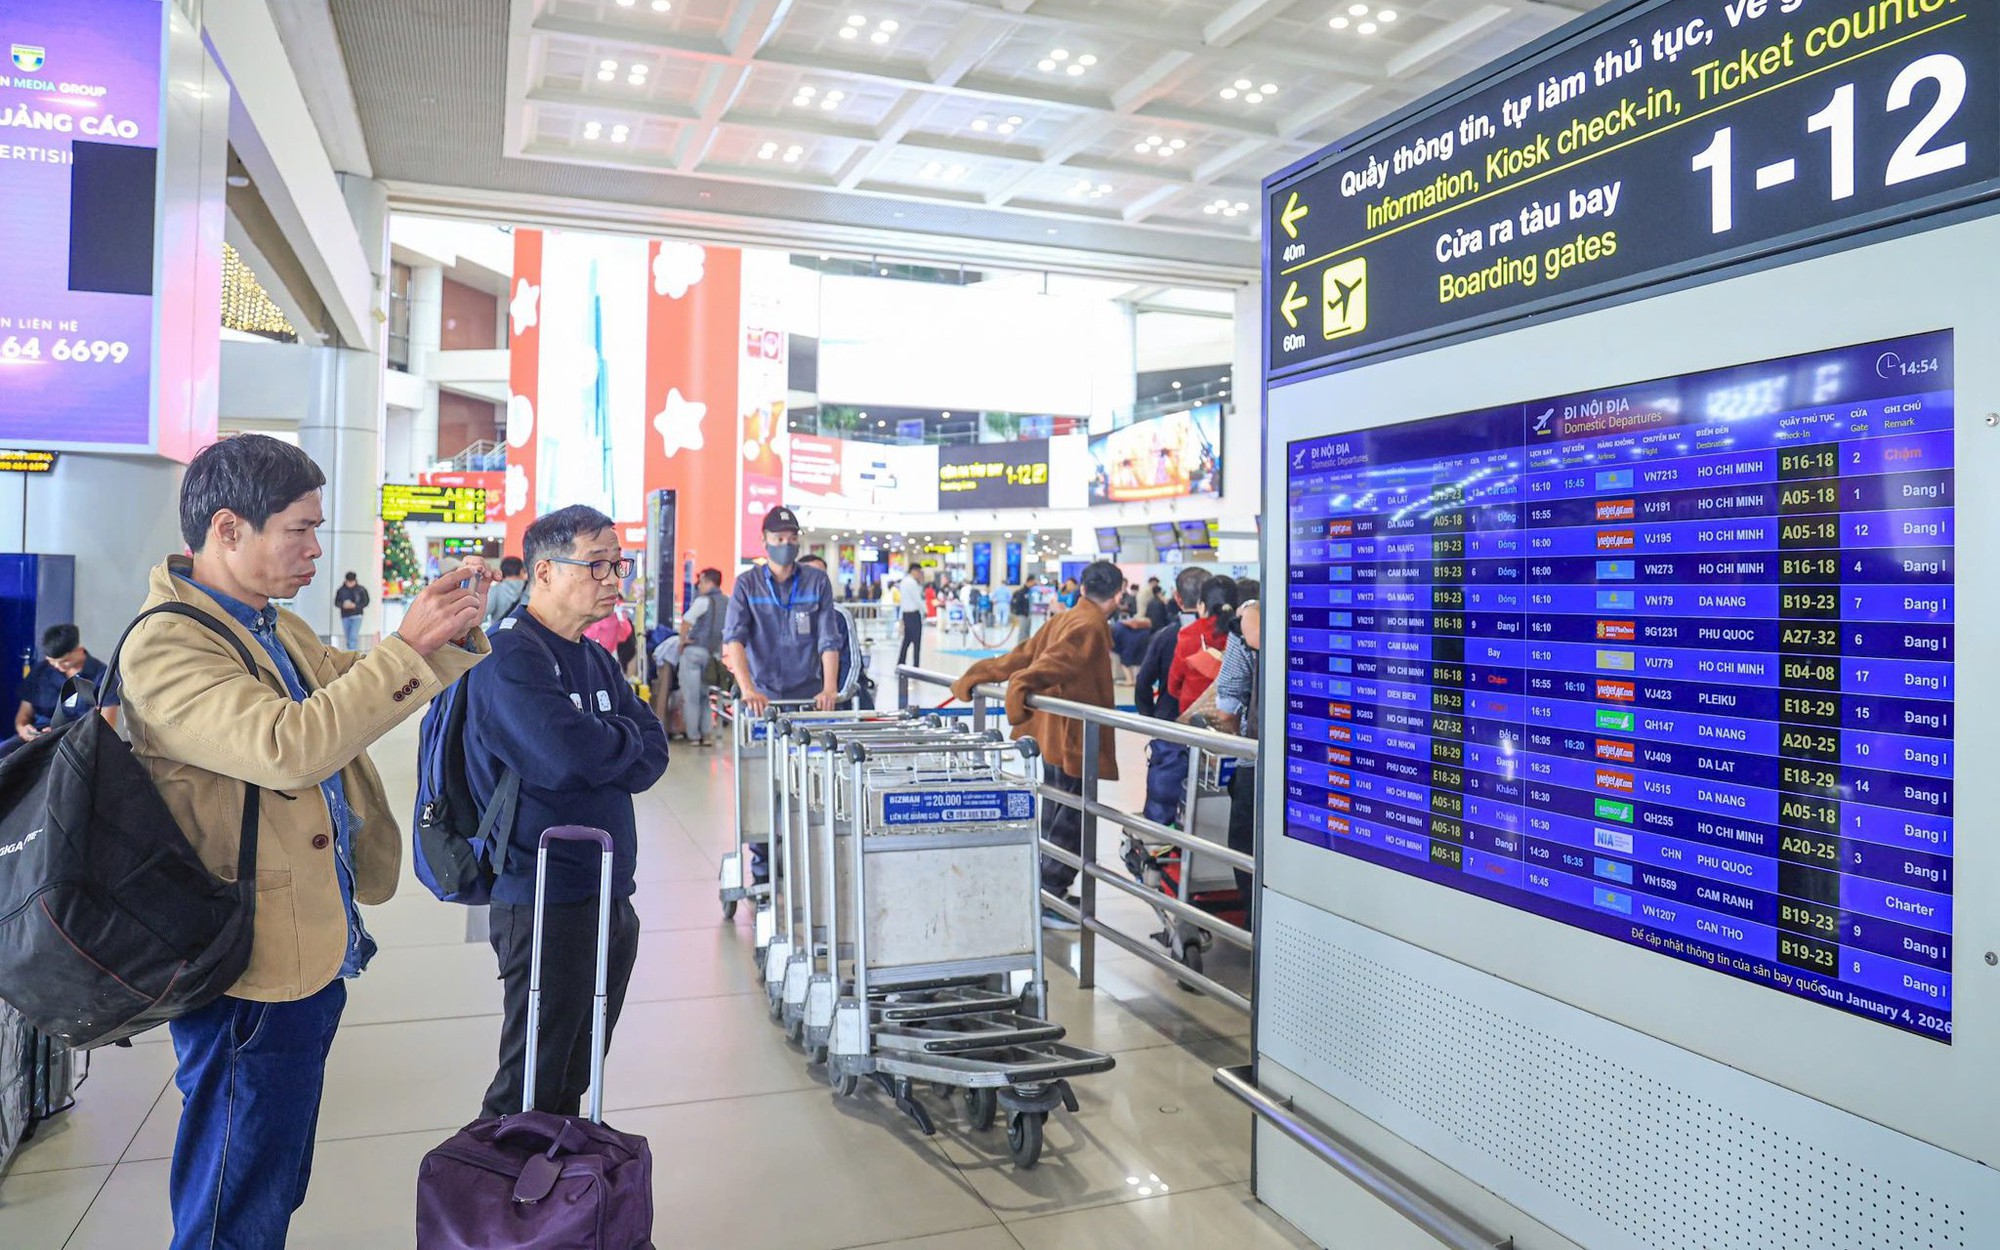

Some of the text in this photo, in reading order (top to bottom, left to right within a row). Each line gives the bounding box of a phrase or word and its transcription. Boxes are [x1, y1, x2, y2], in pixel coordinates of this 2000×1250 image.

[14, 77, 56, 92] MEDIA
[59, 82, 107, 97] GROUP
[1341, 155, 1389, 197] Quầy
[1393, 130, 1454, 175] thông
[1459, 114, 1496, 146] tin,
[1502, 95, 1532, 129] tự
[1538, 71, 1586, 112] làm
[1593, 38, 1642, 86] thủ
[1651, 18, 1713, 63] tục,
[79, 114, 139, 139] CÁO
[1363, 166, 1483, 234] Information,
[1486, 130, 1554, 187] Kiosk
[1557, 83, 1685, 158] check-in,
[1688, 28, 1797, 104] Ticket
[1436, 54, 1967, 263] Cửa ra tàu bay 1-12
[1282, 244, 1305, 262] 40m
[1436, 231, 1617, 303] Boarding gates
[51, 338, 129, 363] 6699
[1283, 333, 1305, 352] 60m
[1899, 358, 1939, 376] 14:54
[1564, 397, 1630, 420] ĐI NỘI ĐỊA
[1564, 411, 1662, 434] Domestic Departures
[1884, 418, 1915, 429] Remark
[1006, 465, 1032, 485] 1-12
[1531, 452, 1834, 492] 15:10 15:45 VN7213 HO CHI MINH B16-18
[1531, 487, 1835, 520] 15:55 VJ191 A05-18
[1433, 514, 1462, 527] A05-18
[1644, 523, 1869, 544] VJ195 A05-18 12
[1433, 540, 1462, 553] B19-23
[1434, 566, 1462, 577] B19-23
[1644, 559, 1835, 575] VN273 HO CHI MINH B16-18
[1434, 591, 1462, 603] B19-23
[1644, 594, 1835, 609] VN179 DA NANG B19-23
[1434, 617, 1462, 629] B16-18
[1644, 626, 1836, 645] 9G1231 PHU QUOC A27-32
[1488, 648, 1501, 659] Bay
[1433, 668, 1462, 681] B16-18
[1532, 650, 1869, 682] 16:10 VU779 E04-08 17
[1433, 693, 1462, 707] B19-23
[1531, 678, 1870, 719] 15:55 16:10 VJ423 PLEIKU E18-29 15
[1432, 719, 1462, 733] A27-32
[1531, 706, 1870, 755] 16:15 QH147 A20-25 10
[1433, 744, 1461, 759] E18-29
[1531, 734, 1870, 792] 16:05 16:20 VJ409 DA LAT E18-29 14
[1433, 769, 1461, 785] E18-29
[933, 795, 962, 806] 20.000
[1432, 795, 1461, 811] A05-18
[1644, 781, 1836, 824] VJ515 A05-18
[1431, 820, 1461, 837] A05-18
[1530, 790, 1835, 860] 16:30 QH255 HO CHI MINH A20-25
[1431, 846, 1460, 863] A05-18
[1597, 831, 1934, 917] NIA CHN PHU QUOC Charter
[1529, 846, 1550, 859] 14:20
[1562, 854, 1584, 867] 16:35
[1642, 873, 1677, 891] VN1559
[1696, 887, 1720, 902] CAM
[1722, 892, 1753, 910] RANH
[1782, 905, 1834, 931] B19-23
[1529, 874, 1837, 966] 16:45 VN1207 CAN THO B19-23
[1631, 927, 1794, 987] Để cập nhật thông tin của sân bay
[1820, 984, 1952, 1034] Sun January 4, 2026
